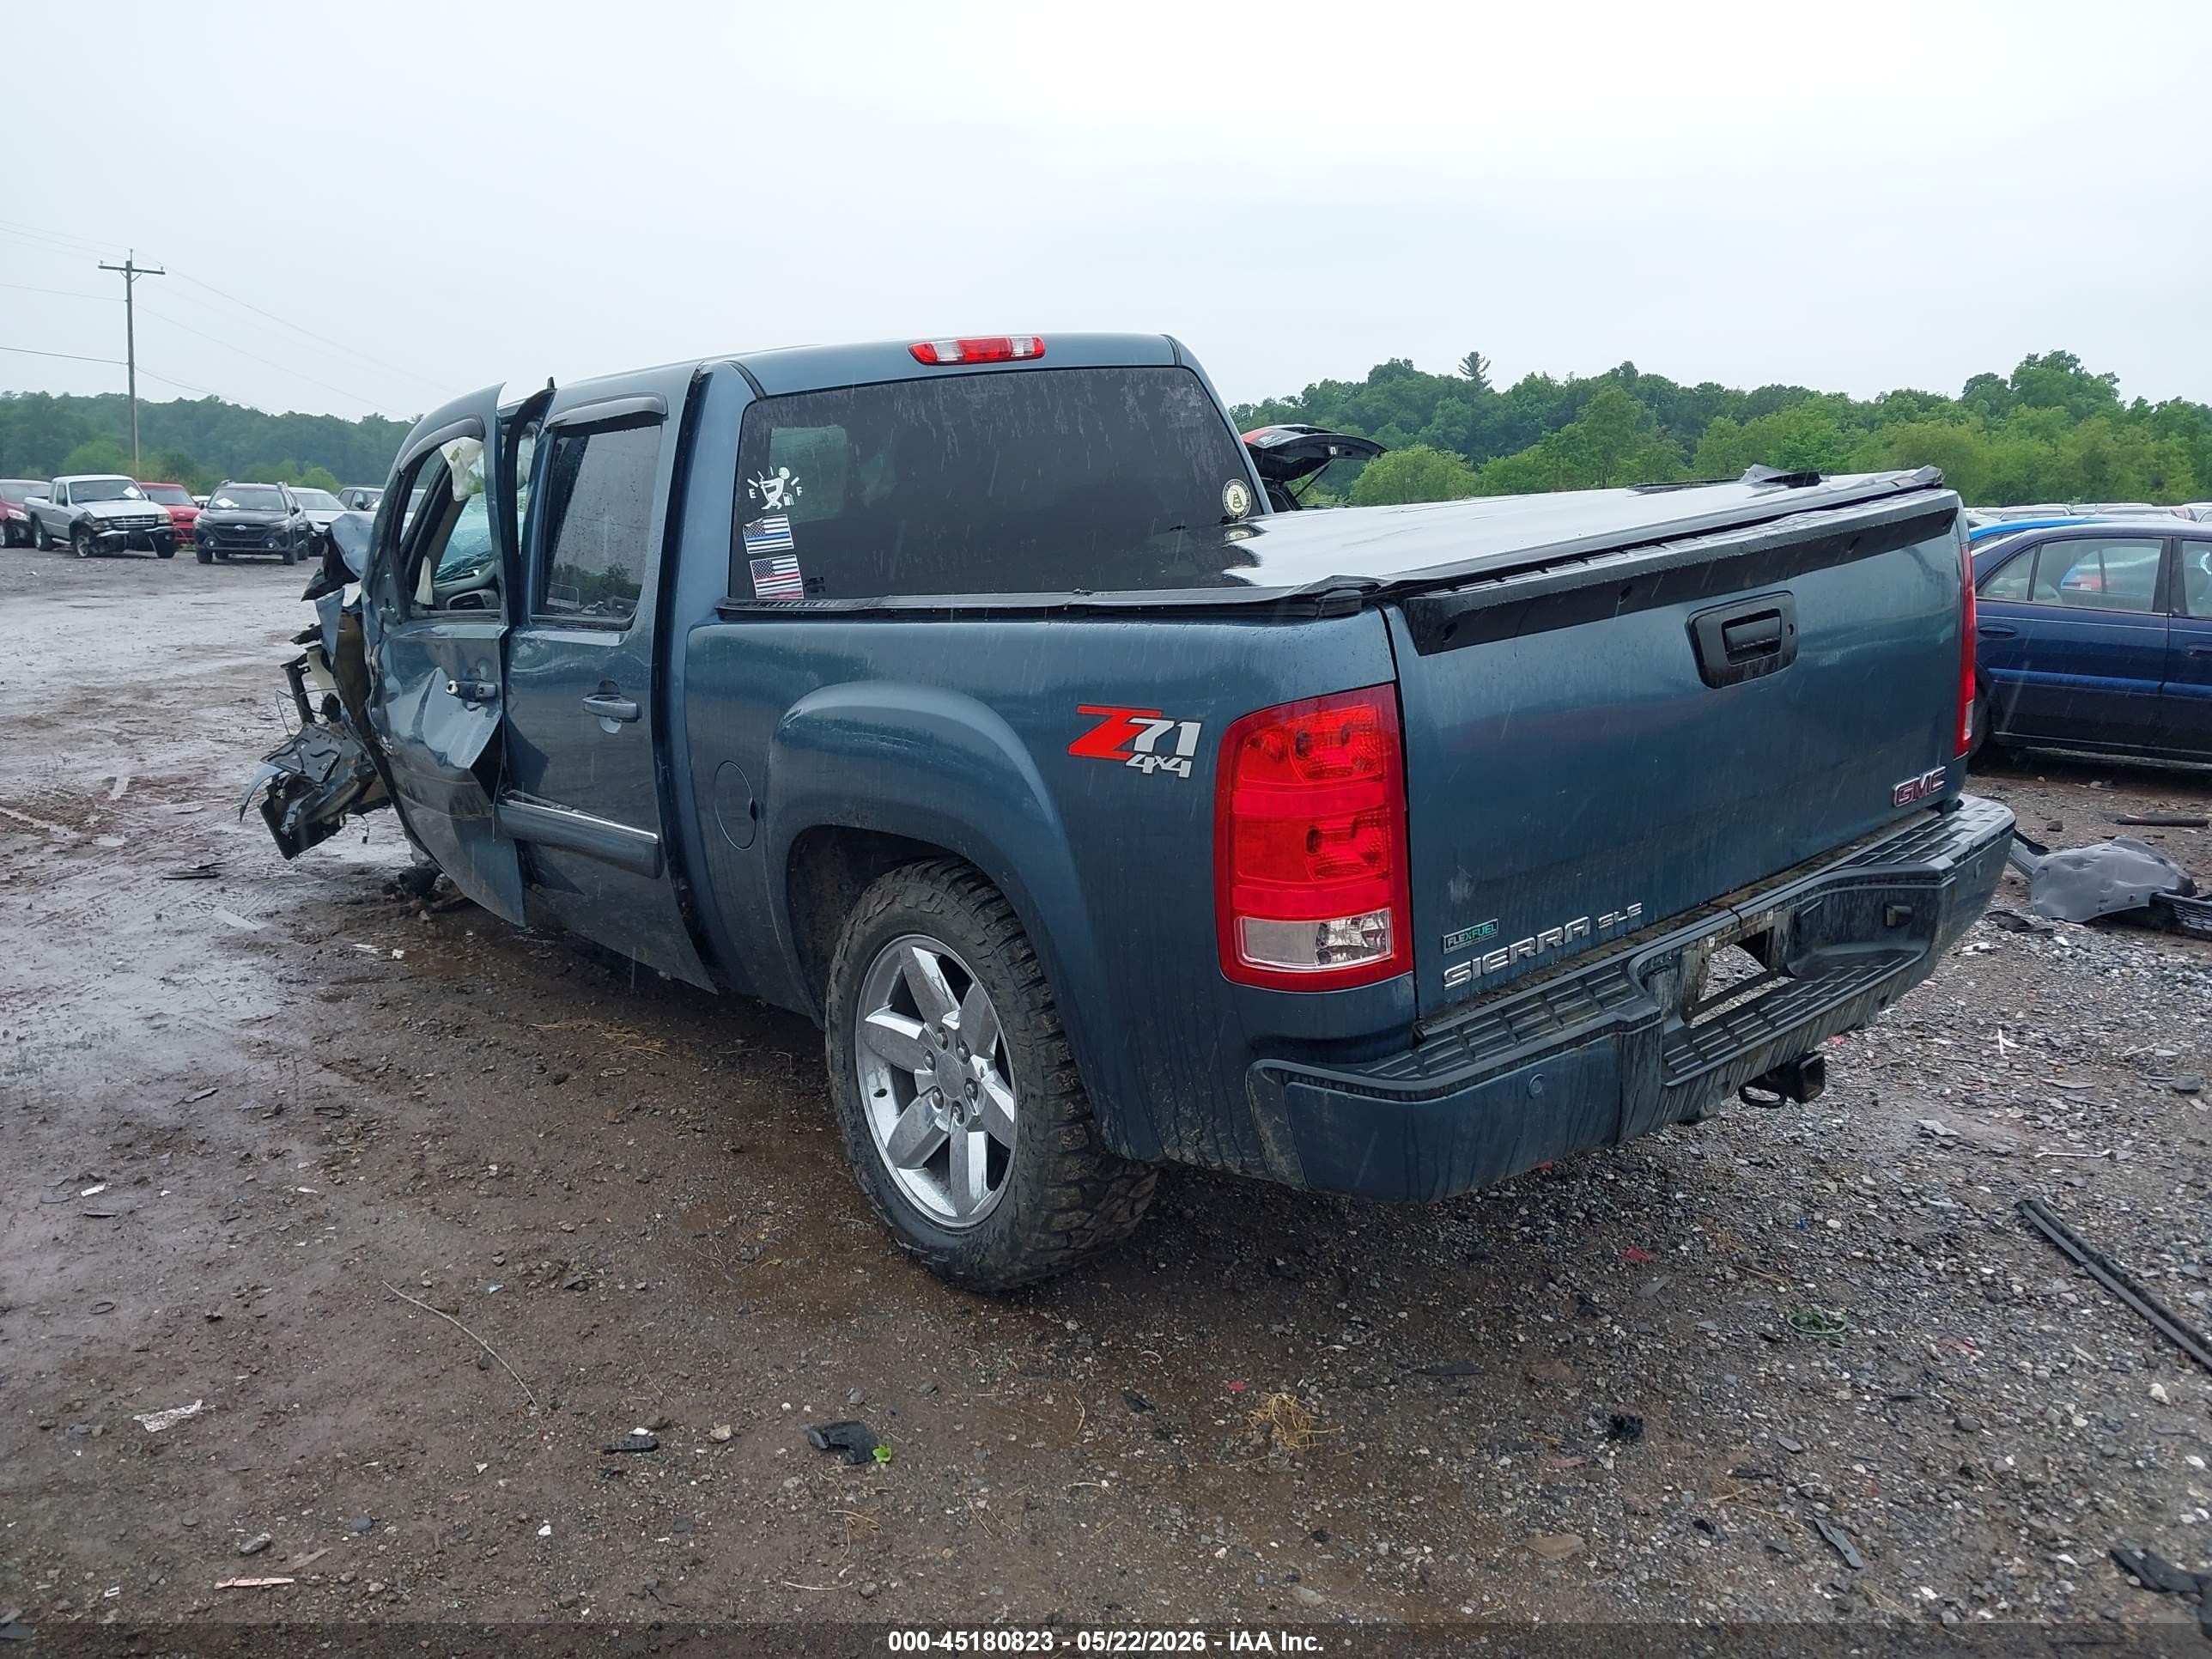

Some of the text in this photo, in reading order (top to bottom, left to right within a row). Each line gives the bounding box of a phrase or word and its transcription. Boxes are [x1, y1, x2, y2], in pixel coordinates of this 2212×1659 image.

[749, 489, 756, 499] E
[796, 486, 803, 496] F
[1067, 705, 1202, 761] Z71
[1893, 766, 1947, 808] GMC
[1443, 902, 1643, 991] SIERRA SLE
[1447, 924, 1497, 948] FLEXFUEL
